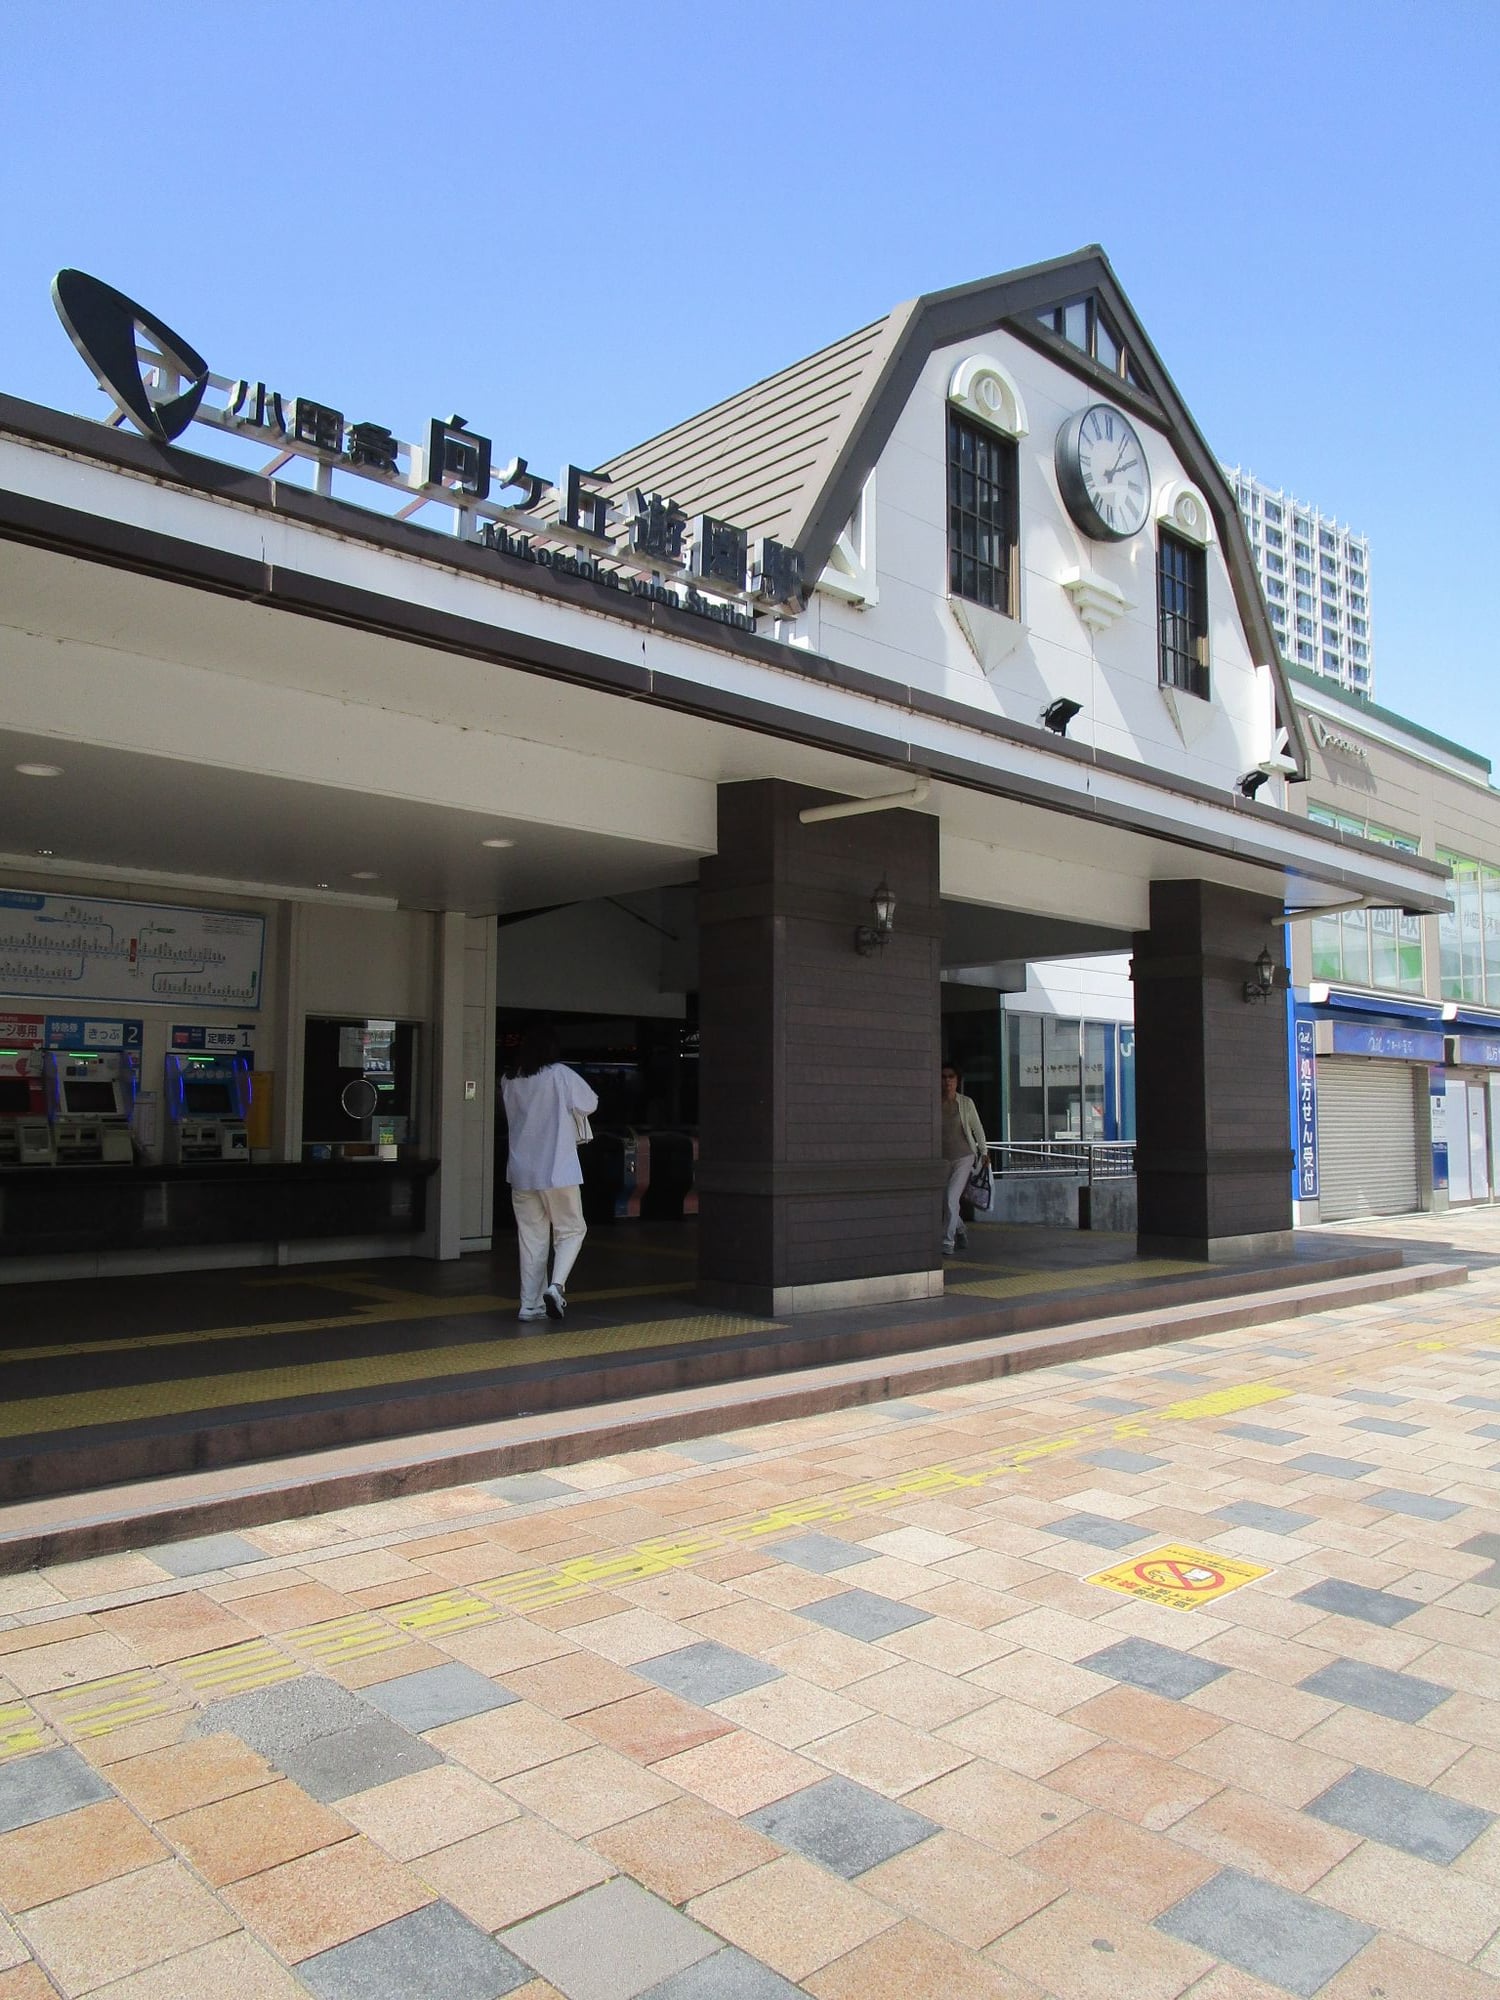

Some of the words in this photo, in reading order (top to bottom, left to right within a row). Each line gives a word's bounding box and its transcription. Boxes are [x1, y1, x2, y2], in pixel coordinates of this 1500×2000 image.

[227, 379, 400, 476] 小田急
[689, 583, 757, 633] Station
[88, 1028, 120, 1040] きっぷ
[127, 1026, 138, 1043] 2
[207, 1033, 236, 1044] 定期券
[242, 1031, 250, 1047] 1
[1300, 1058, 1316, 1191] 処方せん受付
